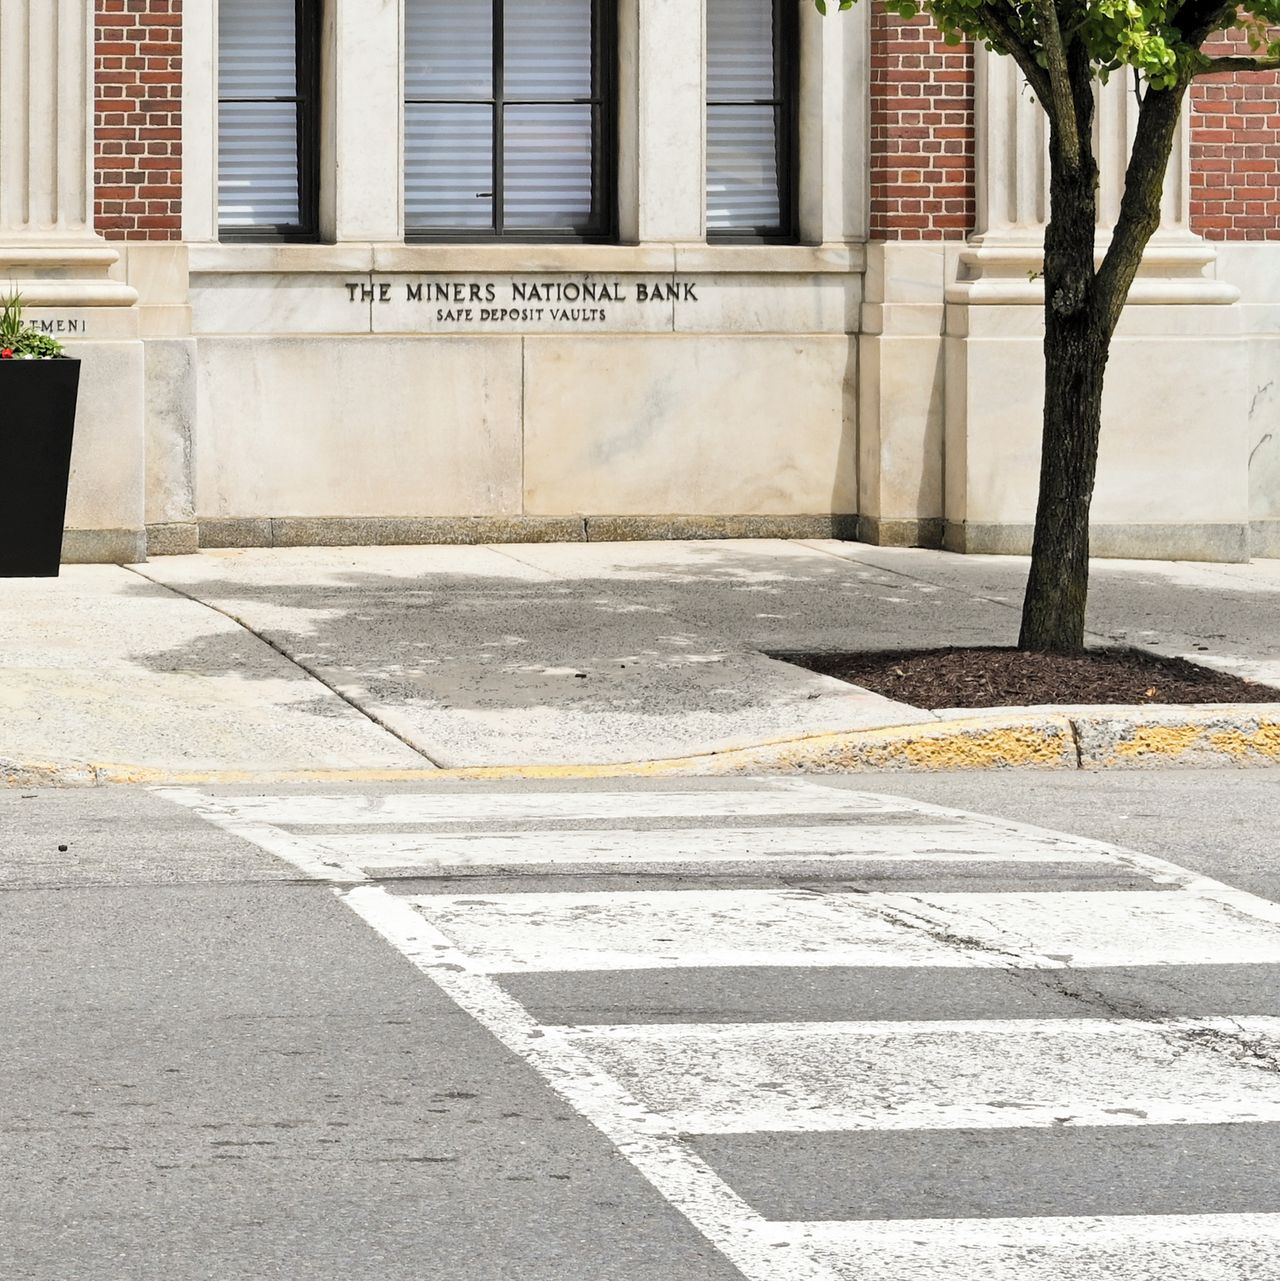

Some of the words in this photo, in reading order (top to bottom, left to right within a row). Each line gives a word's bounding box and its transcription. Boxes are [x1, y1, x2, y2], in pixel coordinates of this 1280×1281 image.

[345, 283, 392, 302] THE
[406, 283, 496, 302] MINERS
[511, 282, 626, 302] NATIONAL
[636, 282, 699, 302] BANK
[437, 308, 473, 322] SAFE
[479, 308, 544, 322] DEPOSIT
[549, 308, 606, 322] VAULTS
